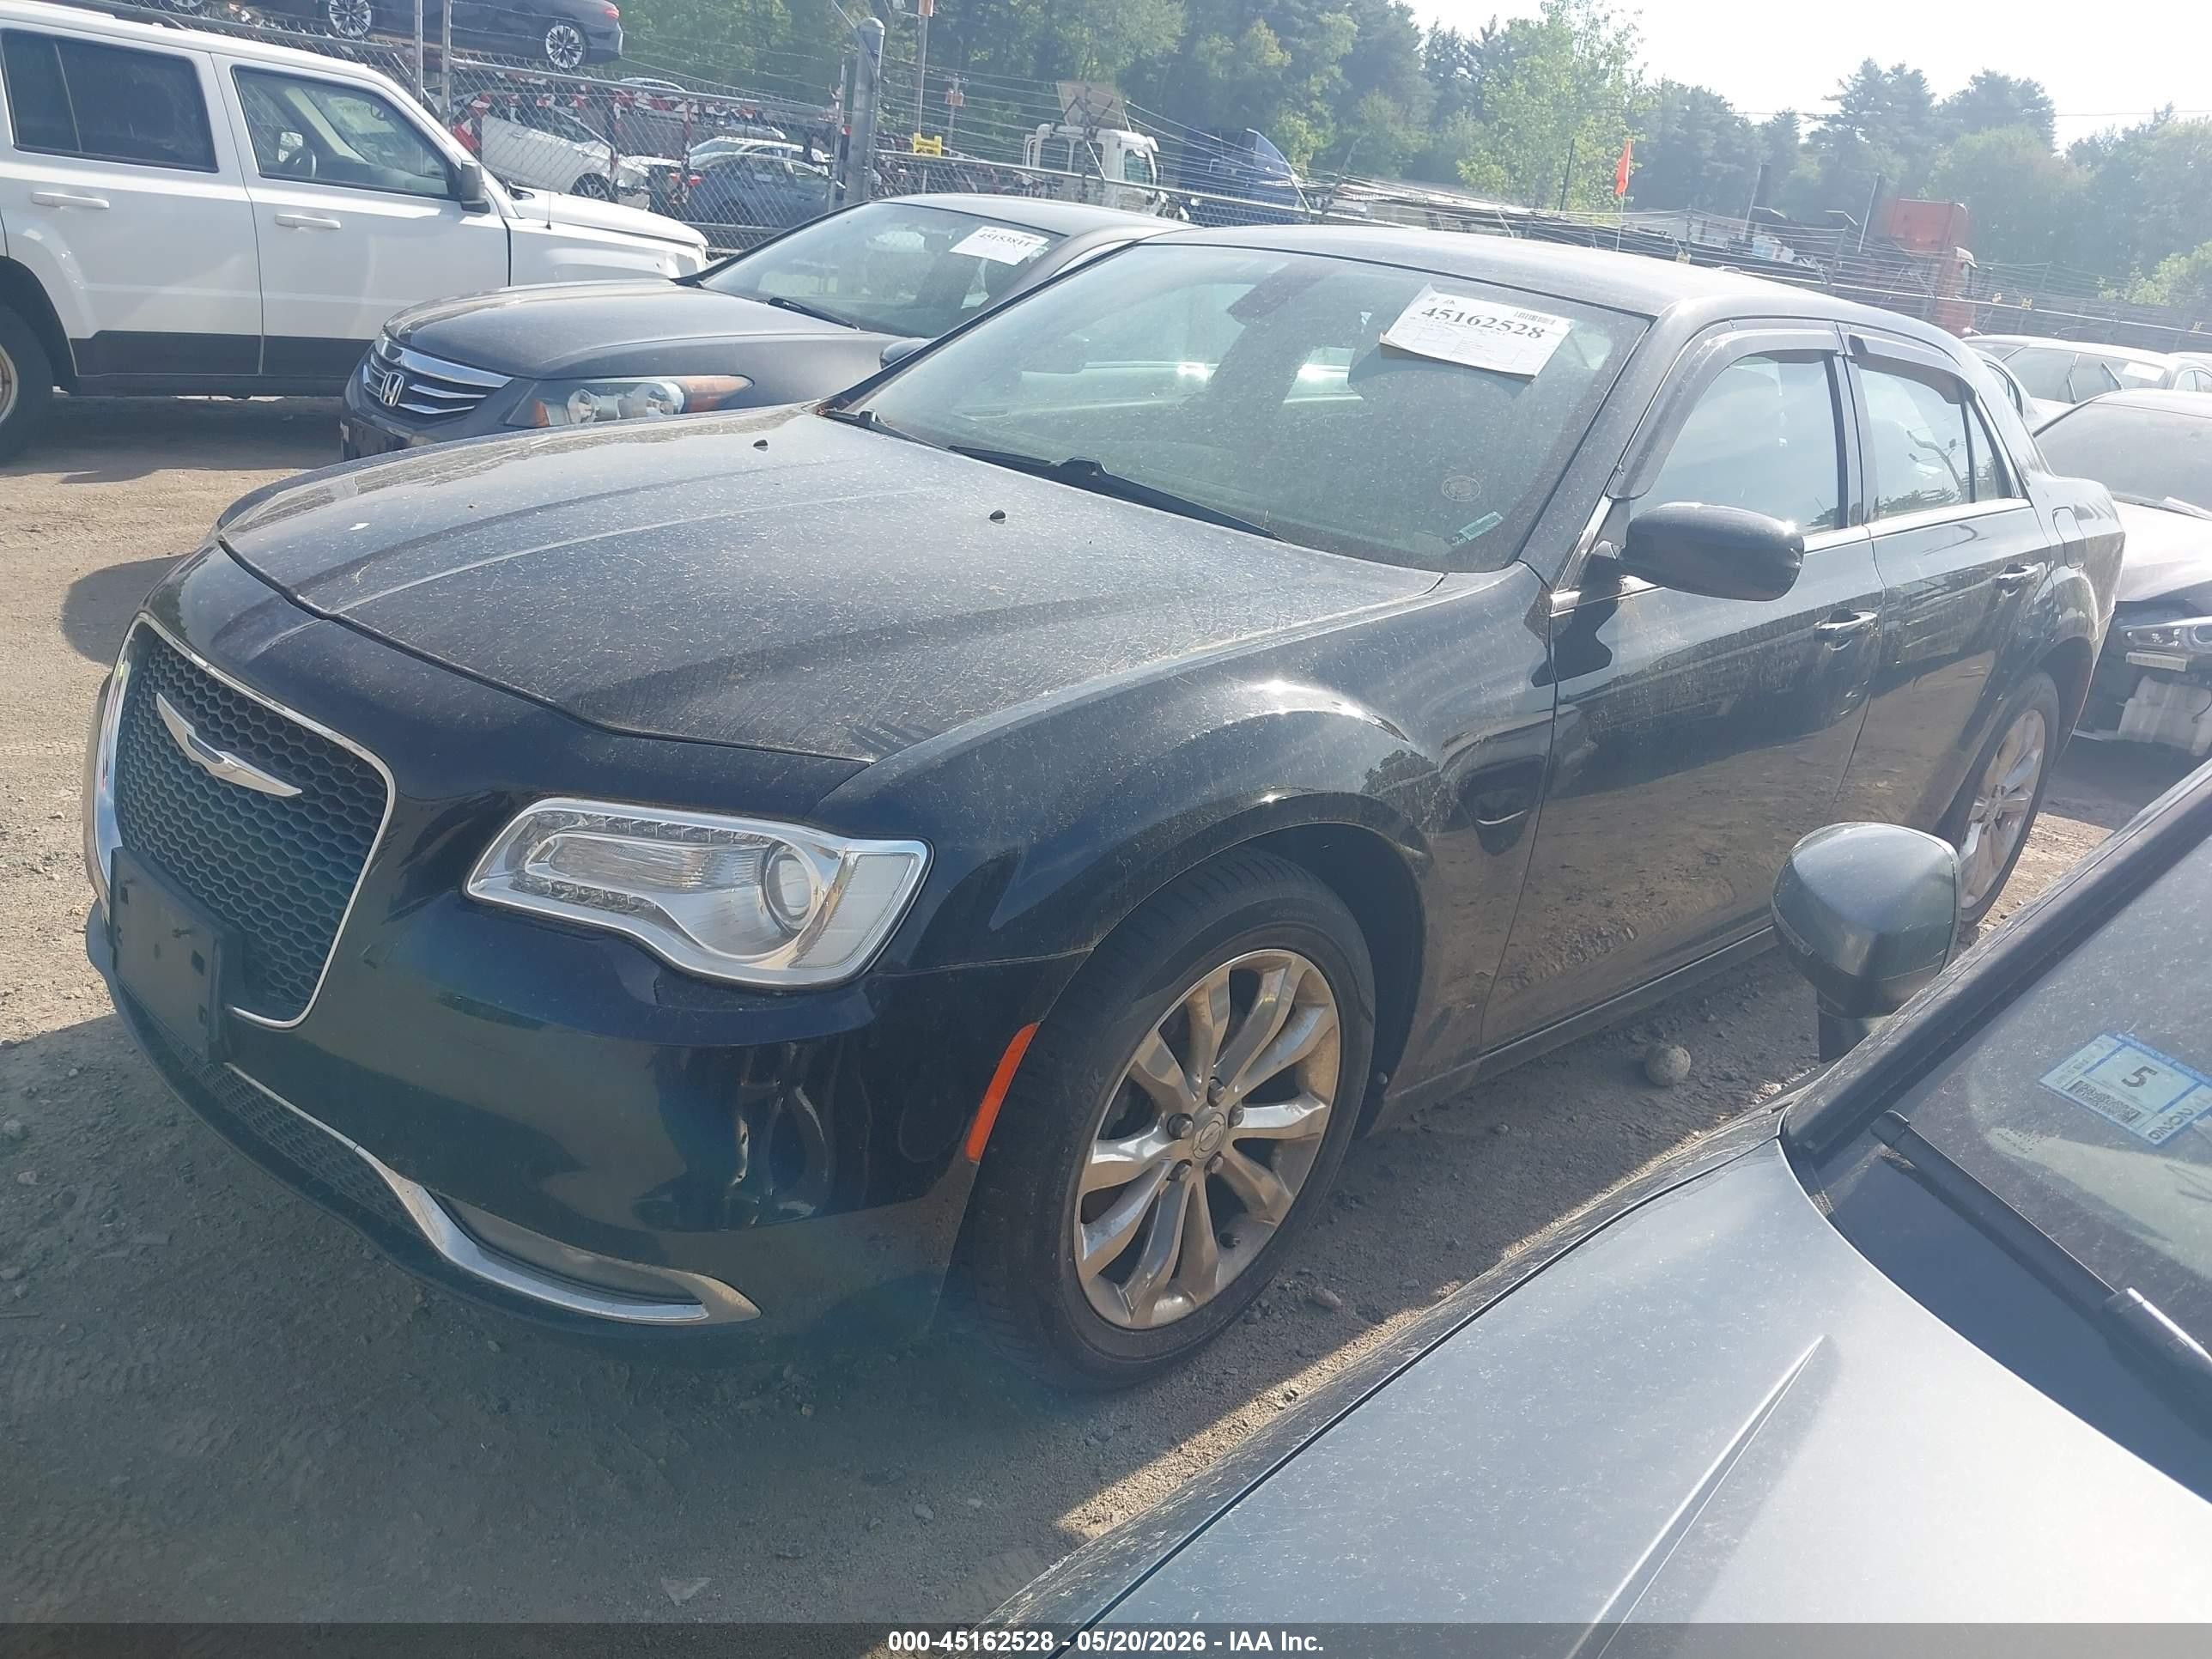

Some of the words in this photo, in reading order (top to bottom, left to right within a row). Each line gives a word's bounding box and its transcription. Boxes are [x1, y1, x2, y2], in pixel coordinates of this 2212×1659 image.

[1421, 307, 1546, 339] 45162528
[2121, 1066, 2158, 1088] 5
[2148, 1108, 2194, 1140] 2026
